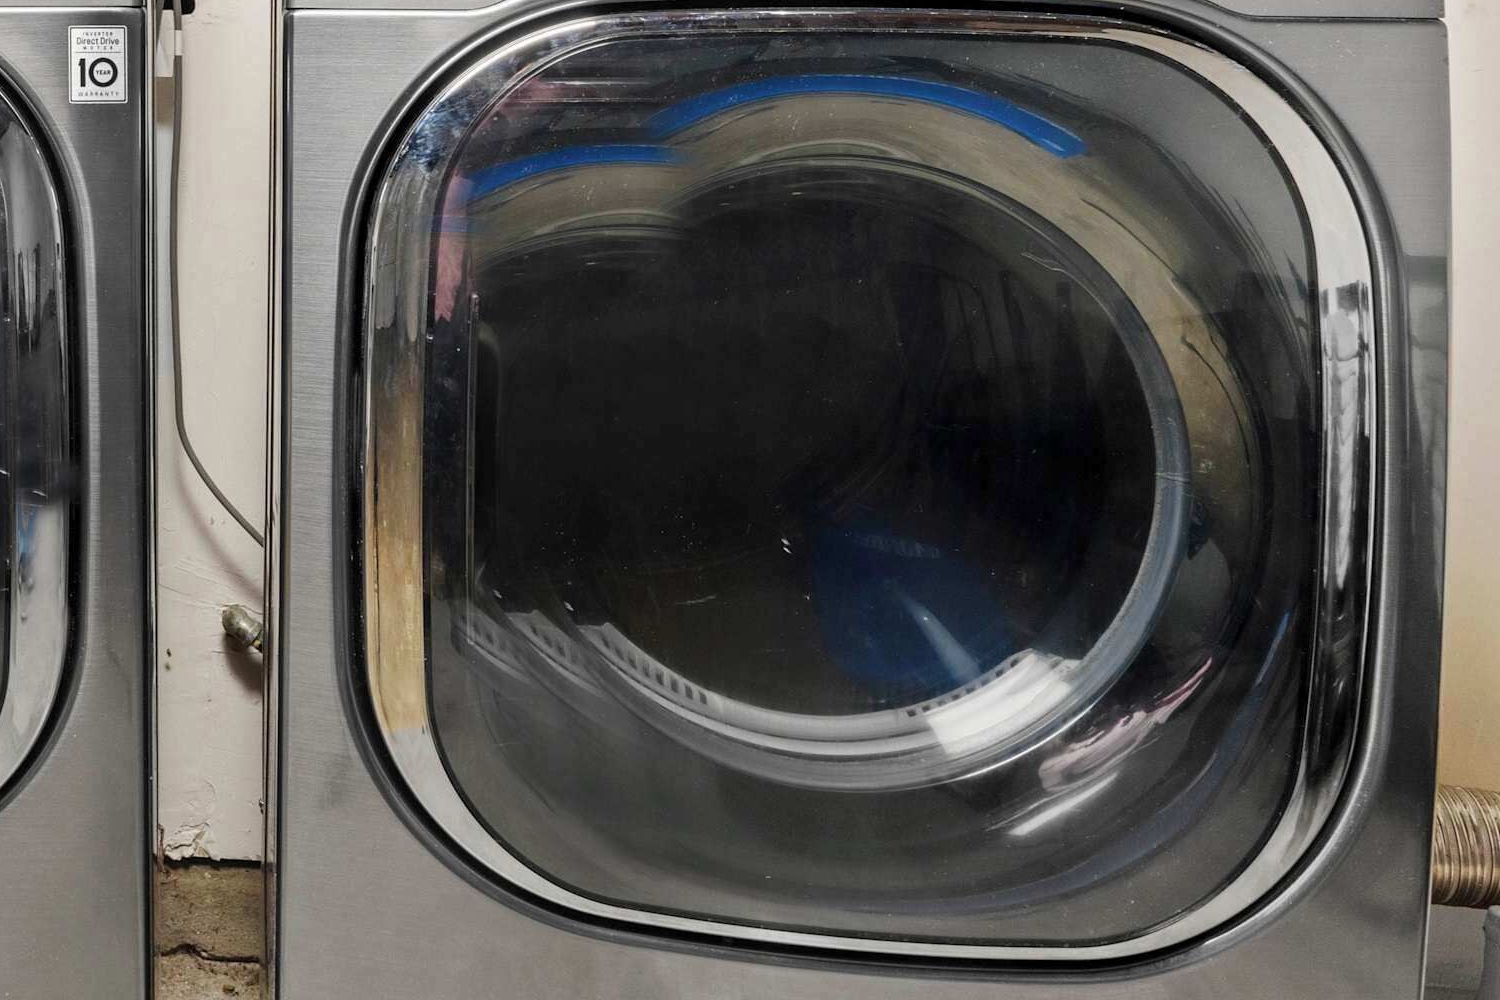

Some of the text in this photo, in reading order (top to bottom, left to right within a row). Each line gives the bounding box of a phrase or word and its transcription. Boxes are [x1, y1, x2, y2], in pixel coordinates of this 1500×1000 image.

[76, 37, 120, 45] Direct Drive
[78, 57, 118, 88] 10
